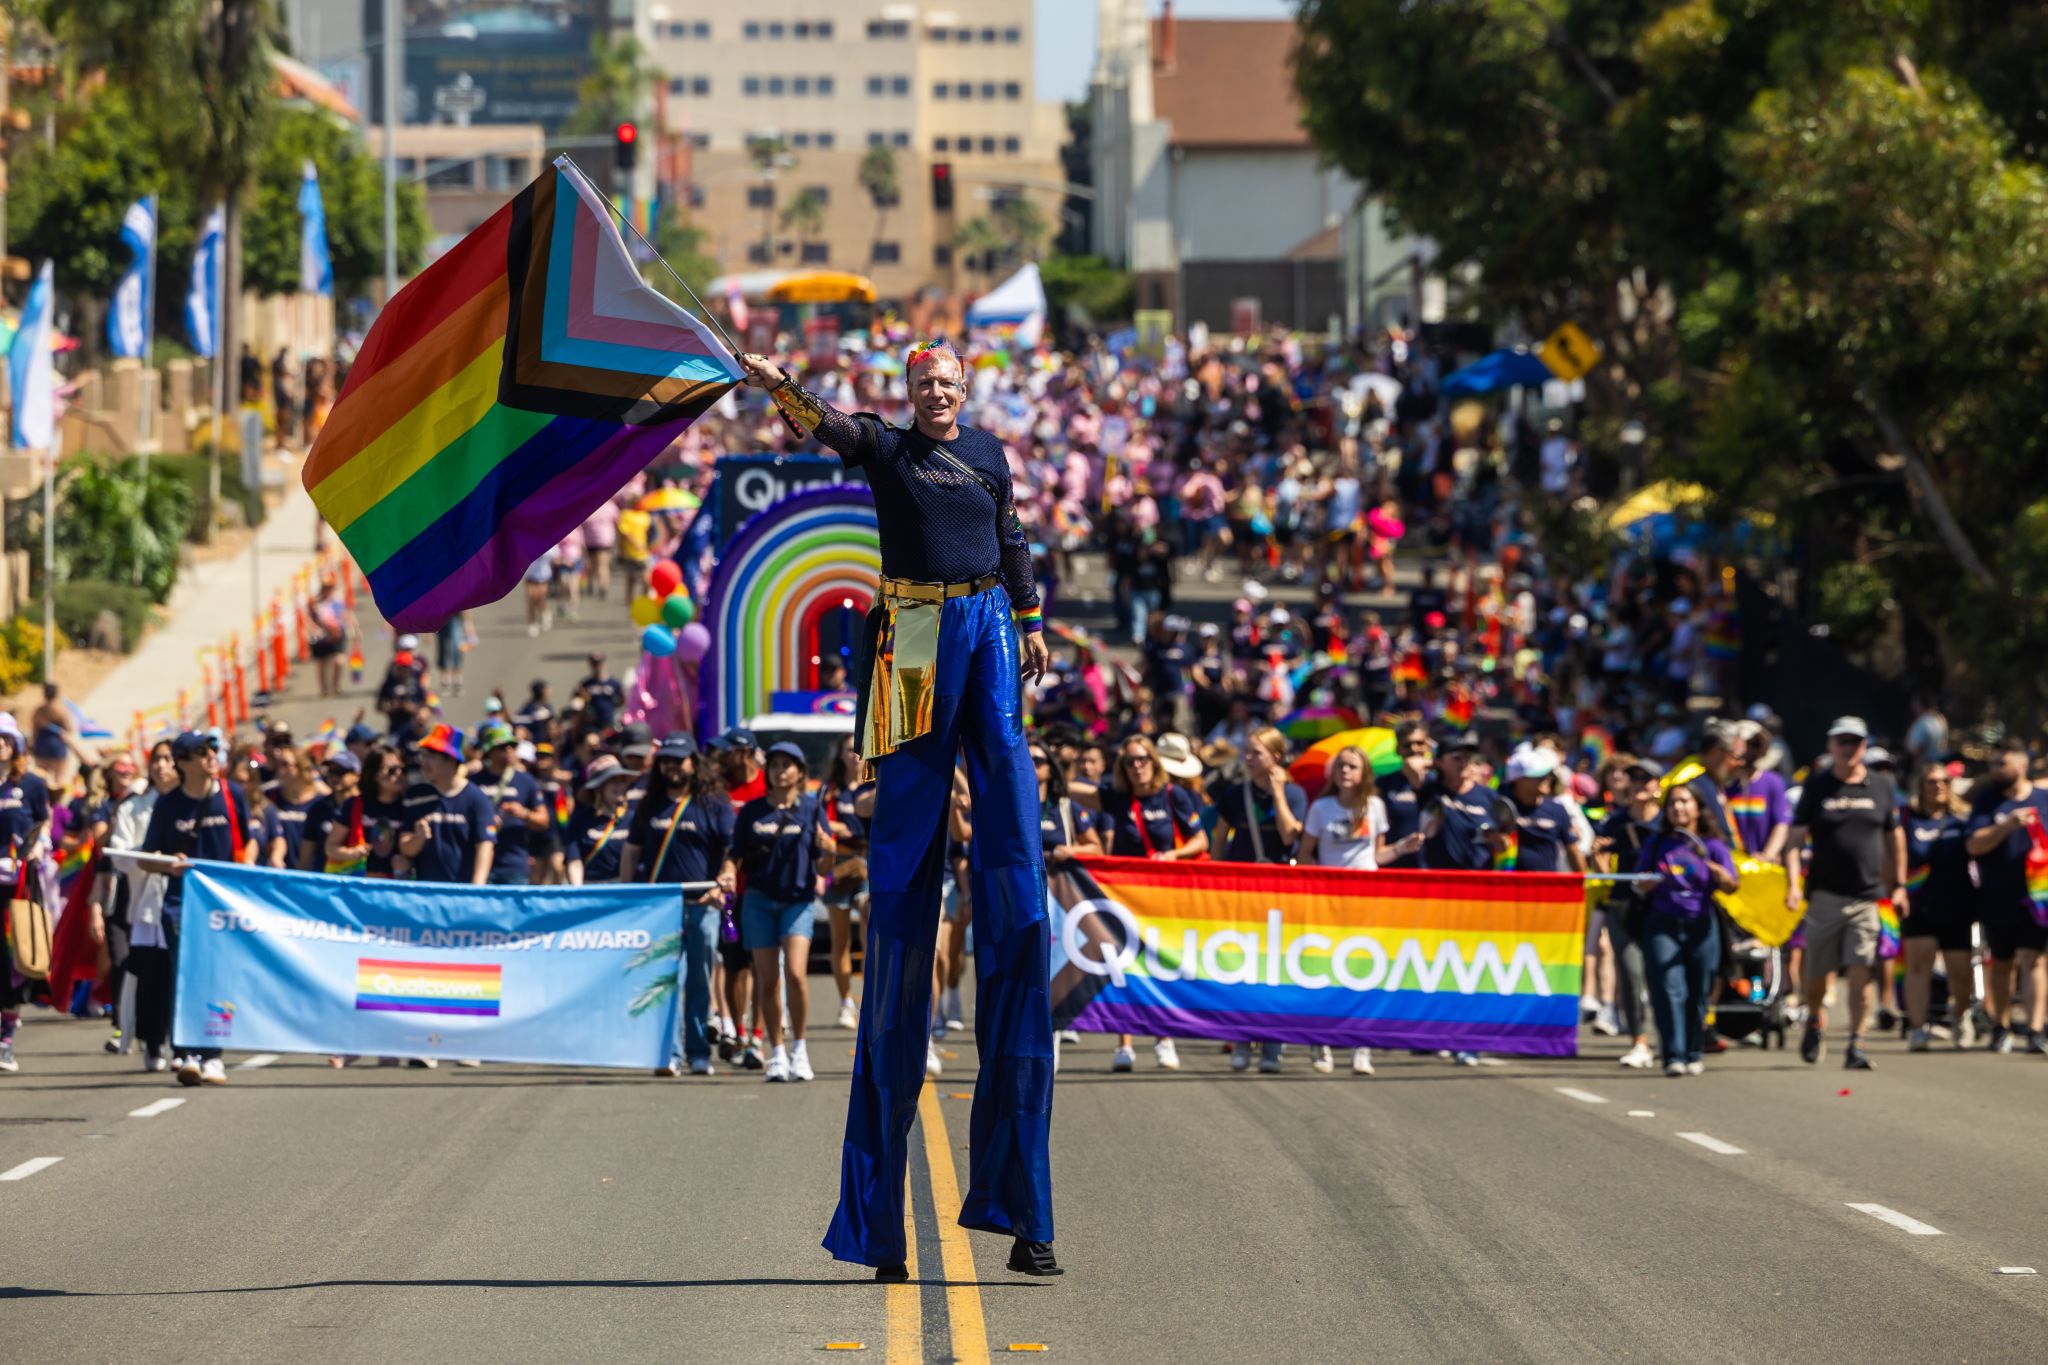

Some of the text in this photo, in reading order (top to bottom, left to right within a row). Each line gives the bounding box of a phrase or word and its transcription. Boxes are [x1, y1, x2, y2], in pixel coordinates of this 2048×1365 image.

[208, 909, 651, 951] STONEWALL PHILANTHROPY AWARD
[1062, 897, 1552, 998] Qualcomm
[373, 972, 483, 998] Qualcomm
